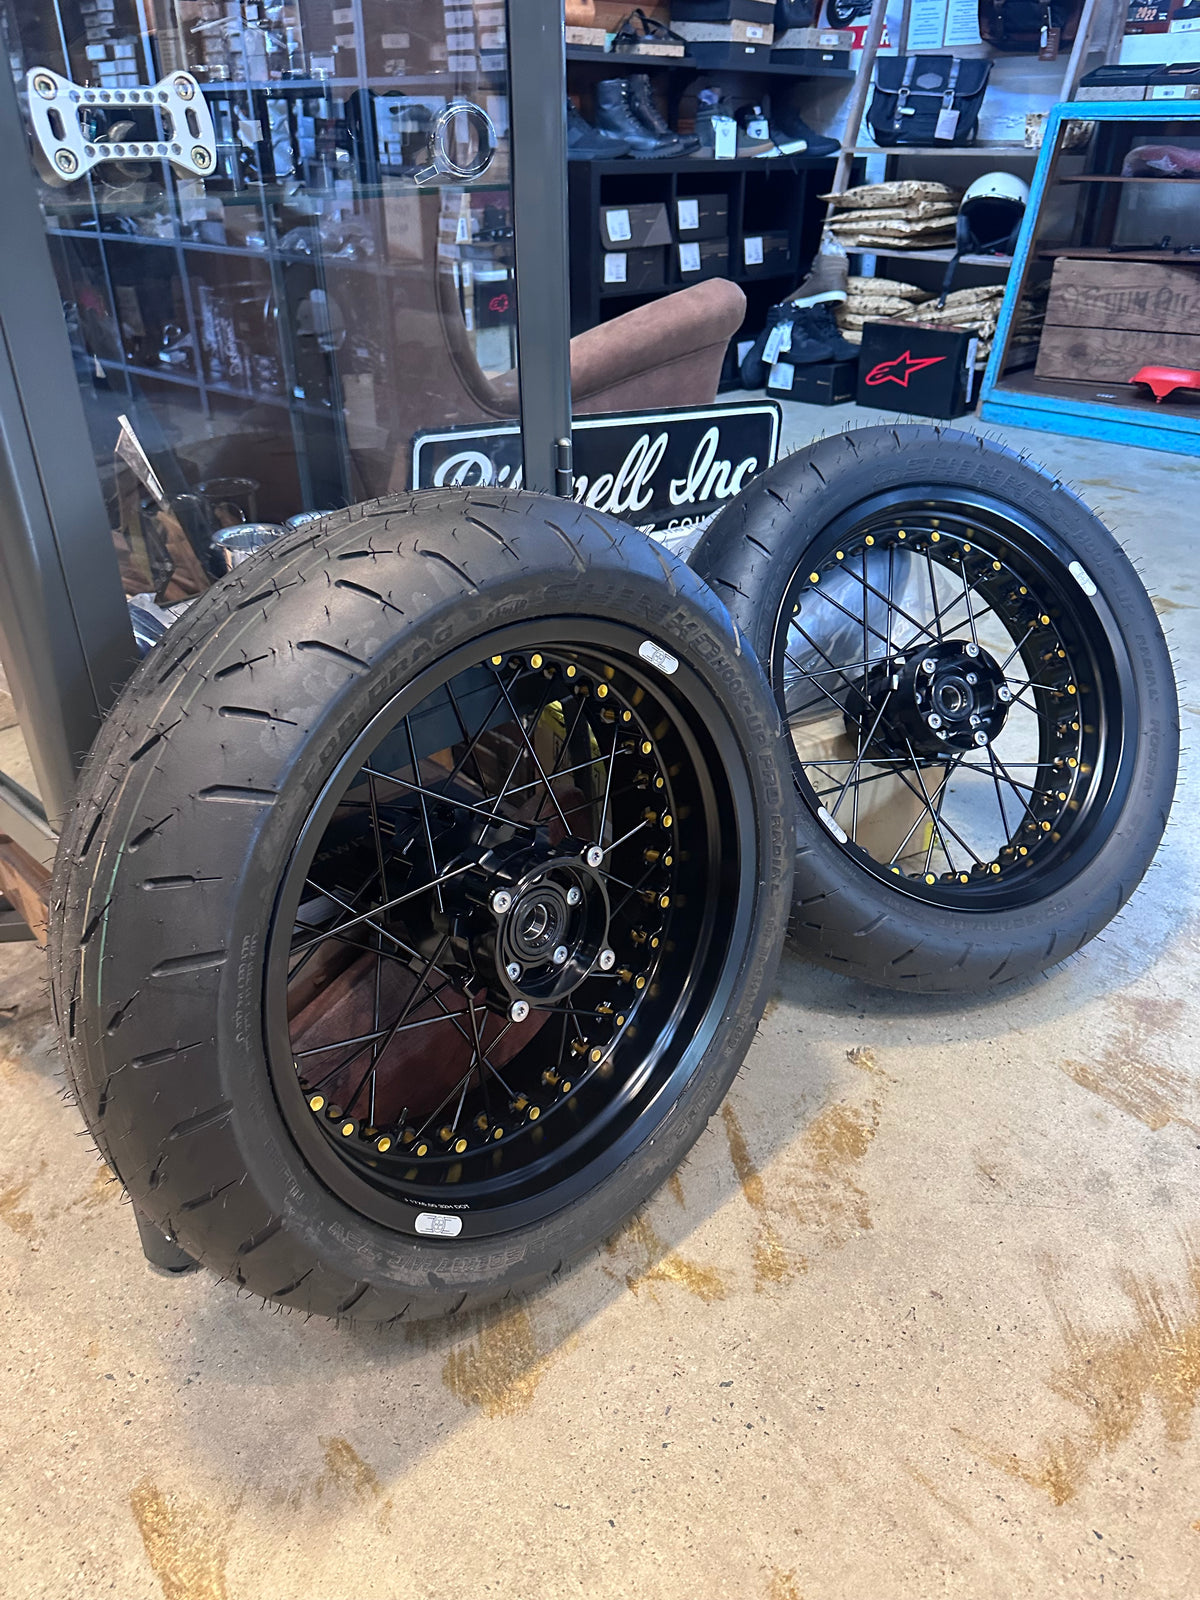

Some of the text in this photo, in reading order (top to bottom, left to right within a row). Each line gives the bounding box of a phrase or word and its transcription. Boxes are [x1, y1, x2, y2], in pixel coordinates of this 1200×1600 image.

[903, 457, 1050, 513] SHINKO
[711, 657, 768, 747] HOOK-UP
[757, 753, 782, 805] PRO
[768, 814, 788, 898] RADIAL
